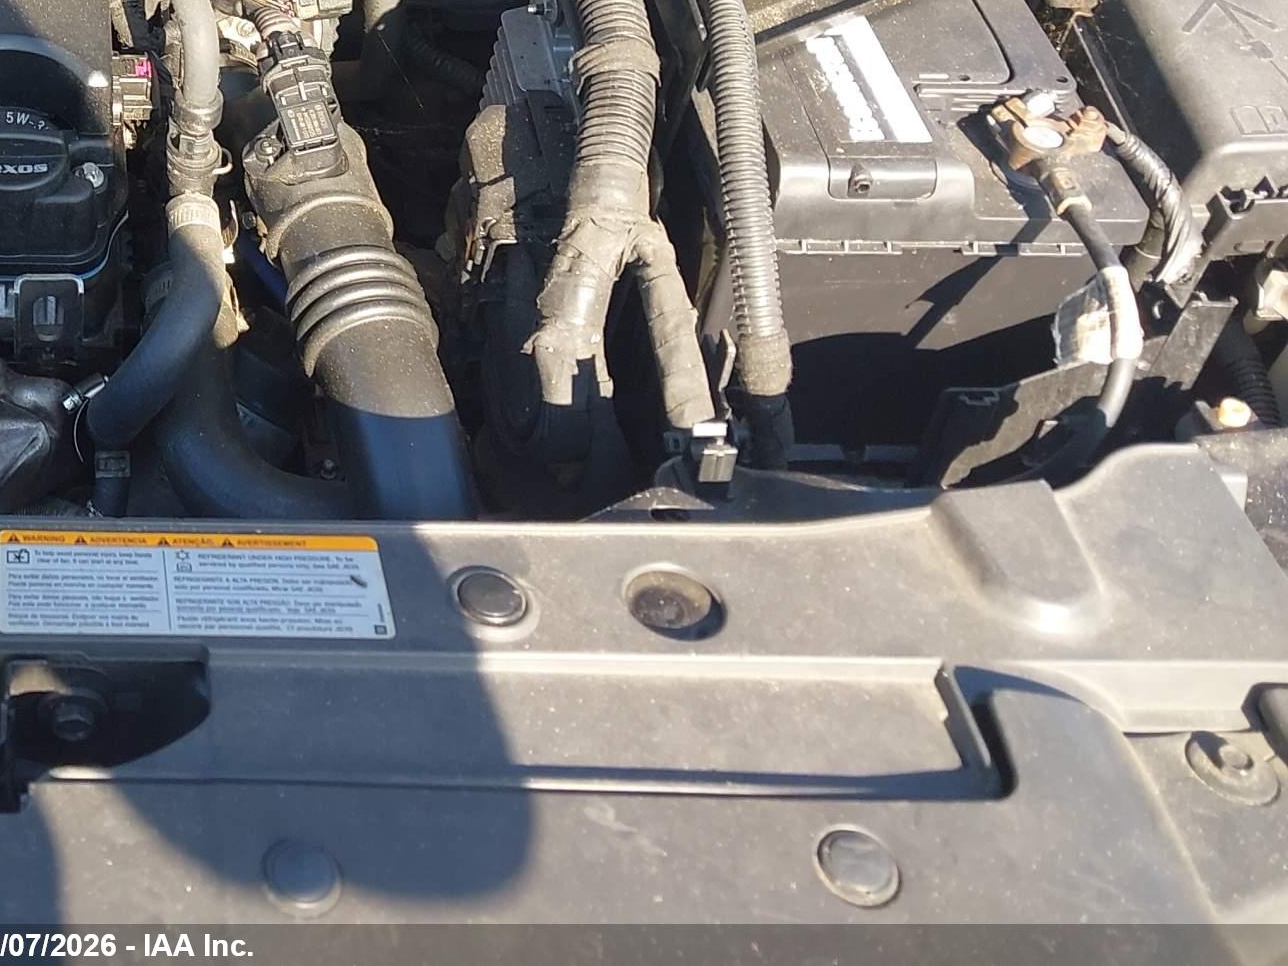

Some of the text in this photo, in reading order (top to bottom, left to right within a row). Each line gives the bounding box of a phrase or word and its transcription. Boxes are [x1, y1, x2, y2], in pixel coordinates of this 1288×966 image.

[6, 111, 50, 130] 5W-3
[22, 534, 65, 543] WARNING
[90, 537, 147, 545] ADVERTENCIA
